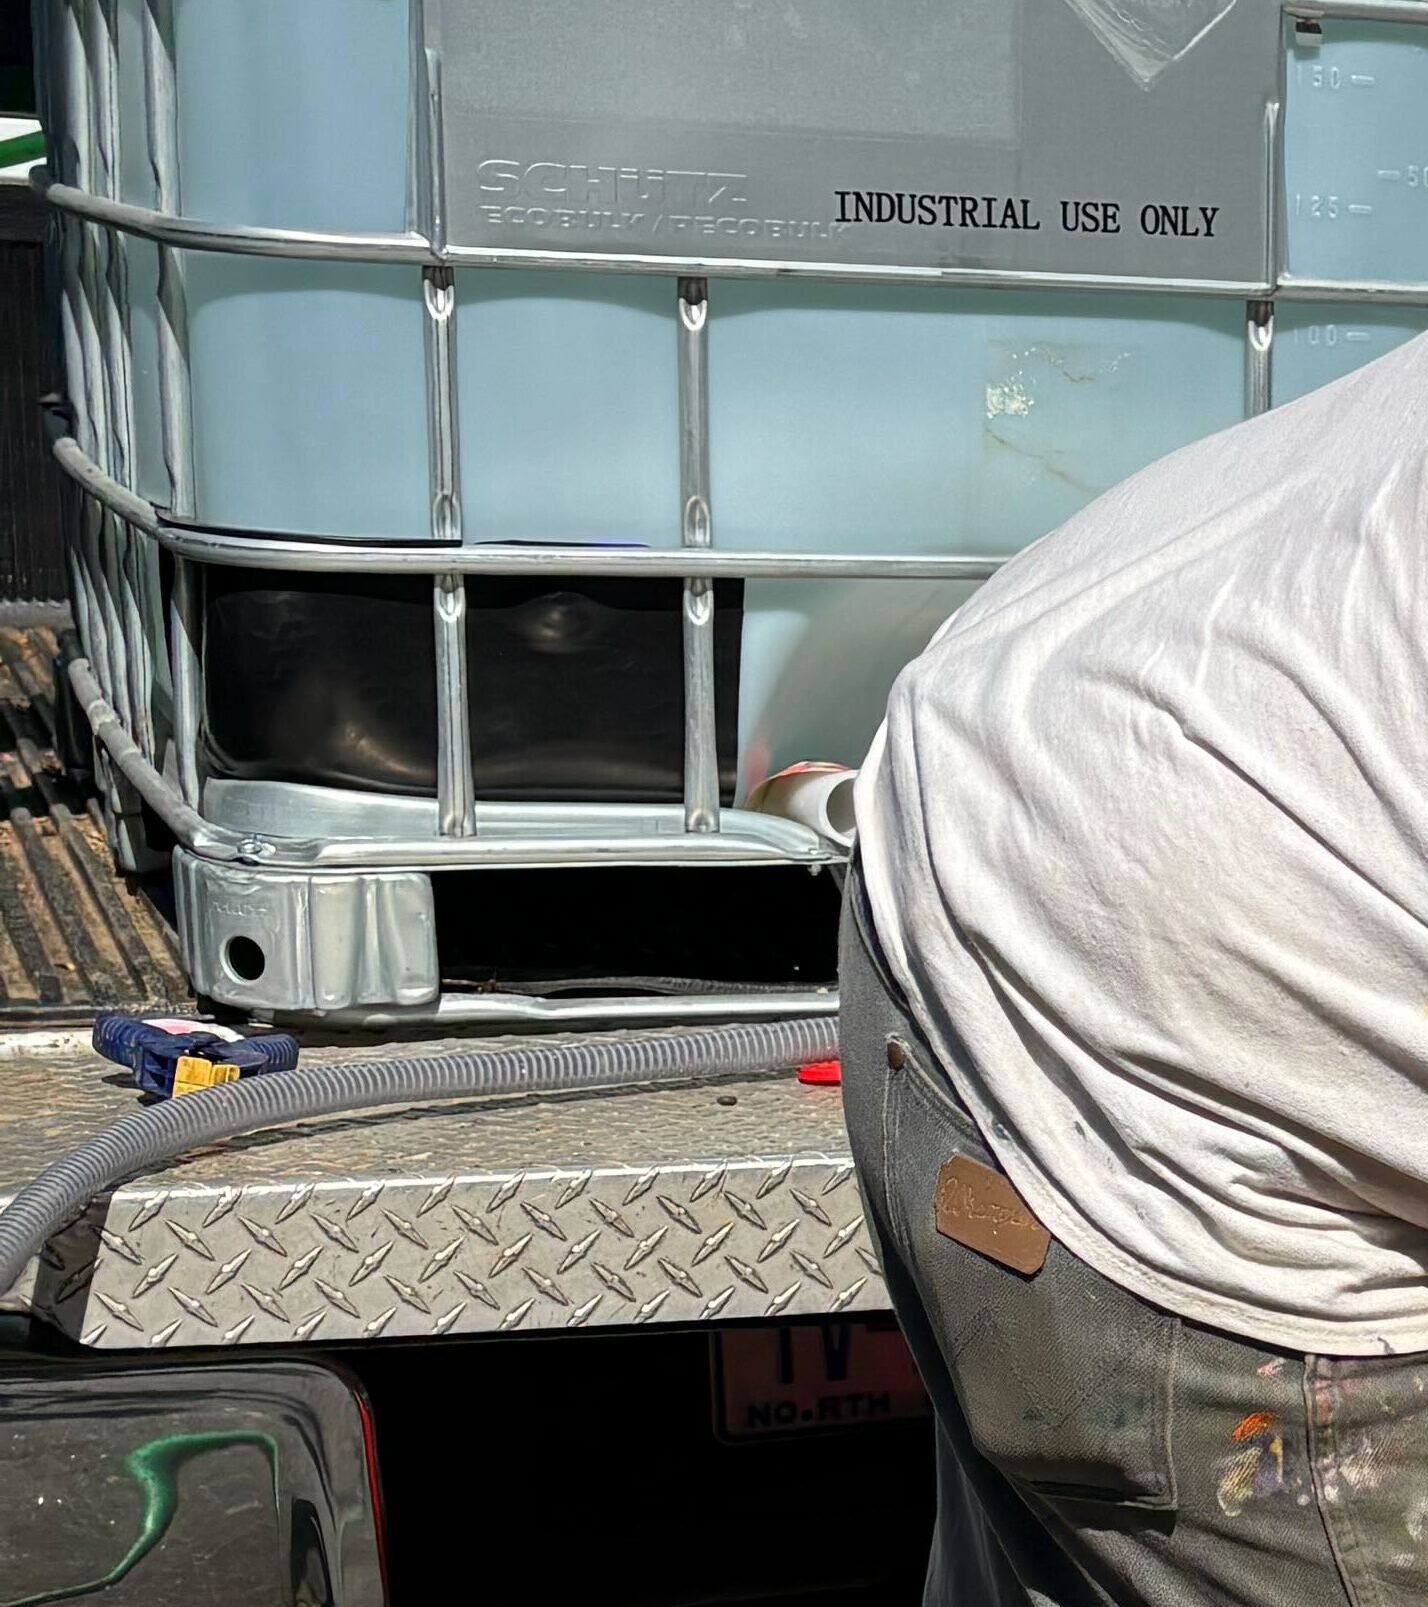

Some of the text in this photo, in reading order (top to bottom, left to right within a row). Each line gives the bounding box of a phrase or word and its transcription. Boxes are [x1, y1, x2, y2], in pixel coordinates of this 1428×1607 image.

[835, 190, 1220, 238] INDUSTRIAL USE ONLY
